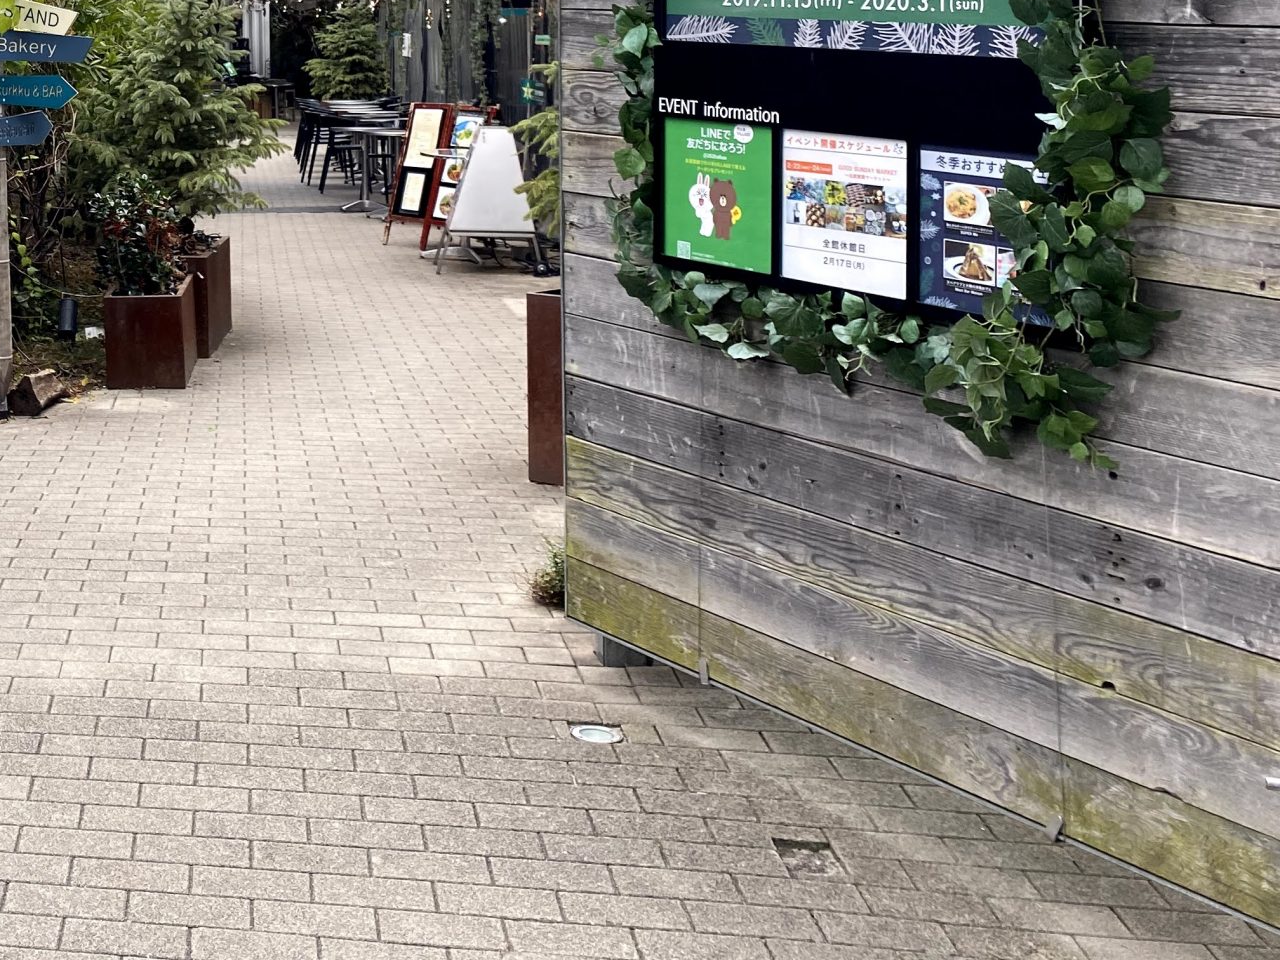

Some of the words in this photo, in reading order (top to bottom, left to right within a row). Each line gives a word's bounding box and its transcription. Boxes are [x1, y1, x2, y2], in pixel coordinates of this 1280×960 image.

[42, 86, 63, 98] BAR
[658, 96, 699, 116] EVENT
[703, 101, 780, 124] information
